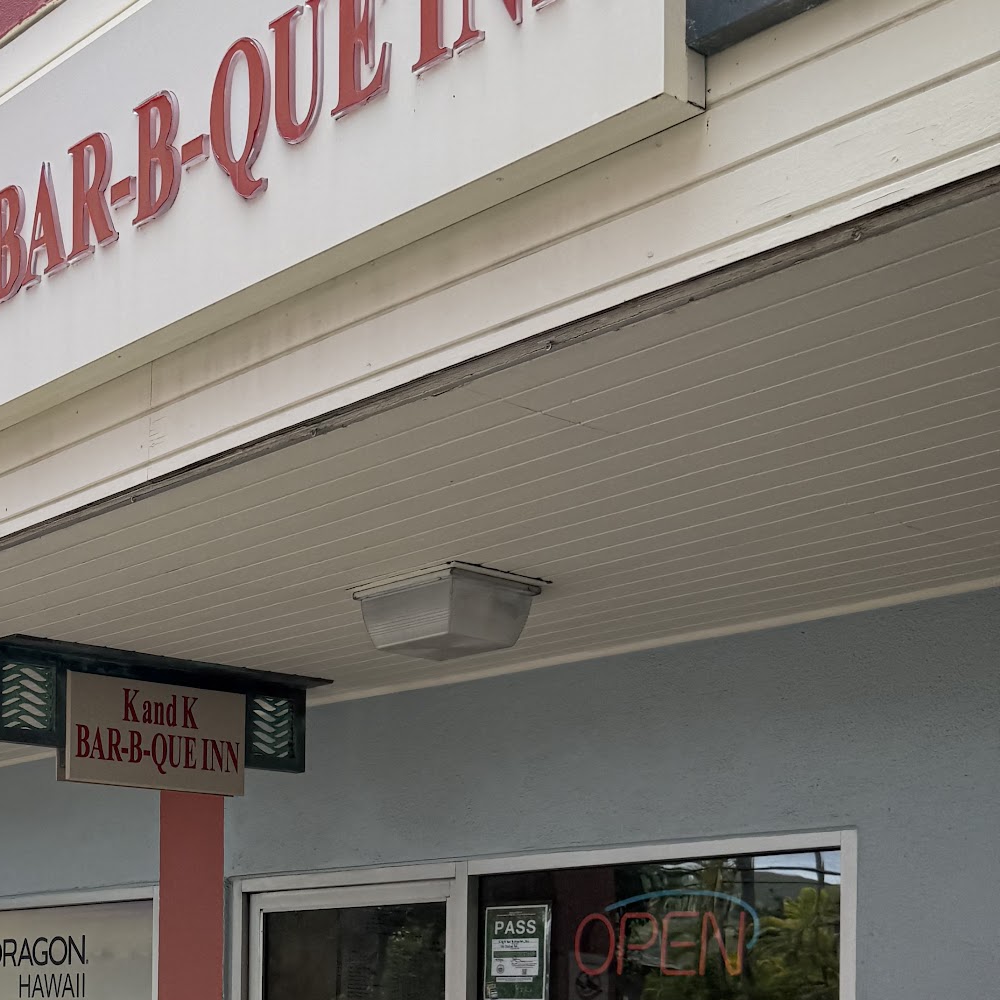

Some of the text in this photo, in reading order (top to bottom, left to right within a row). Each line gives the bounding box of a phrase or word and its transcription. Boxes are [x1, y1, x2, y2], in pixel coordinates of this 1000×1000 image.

[122, 687, 199, 730] K and K
[75, 723, 240, 775] BAR-B-QUE INN
[494, 919, 537, 935] PASS
[574, 911, 746, 976] OPEN
[18, 973, 86, 999] HAWAII
